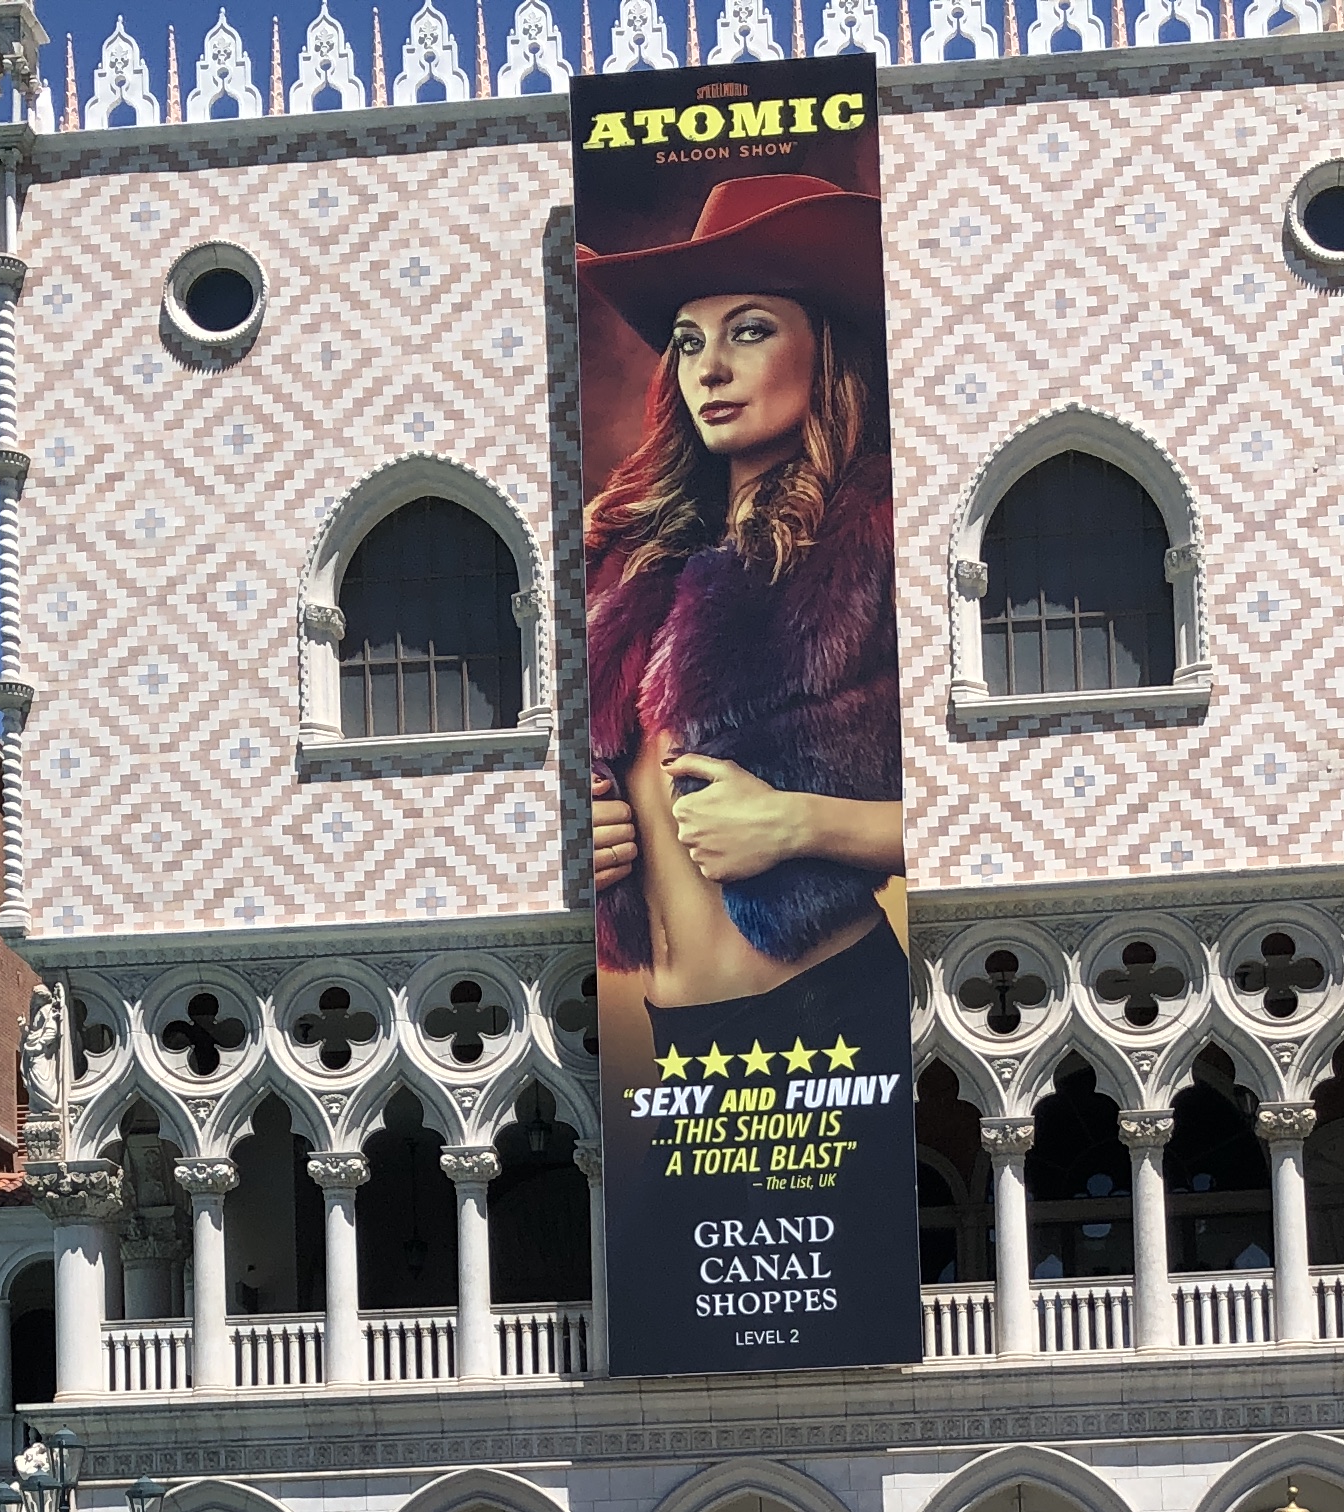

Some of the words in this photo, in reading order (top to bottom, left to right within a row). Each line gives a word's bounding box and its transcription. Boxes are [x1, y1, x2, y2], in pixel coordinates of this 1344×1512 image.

[582, 93, 865, 150] ATOMIC
[656, 147, 729, 164] SALOON
[740, 142, 794, 158] SHOW
[719, 1087, 776, 1113] AND
[785, 1074, 900, 1110] FUNNY
[734, 1112, 812, 1141] SHOW
[818, 1110, 843, 1137] IS
[665, 1151, 683, 1176] A
[693, 1147, 761, 1175] TOTAL
[766, 1176, 786, 1190] The
[790, 1175, 814, 1191] List,
[818, 1173, 837, 1188] UK
[694, 1215, 835, 1248] GRAND
[700, 1252, 832, 1284] CANAL
[696, 1288, 837, 1317] SHOPPES
[735, 1330, 786, 1346] LEVEL
[789, 1329, 800, 1343] 2
